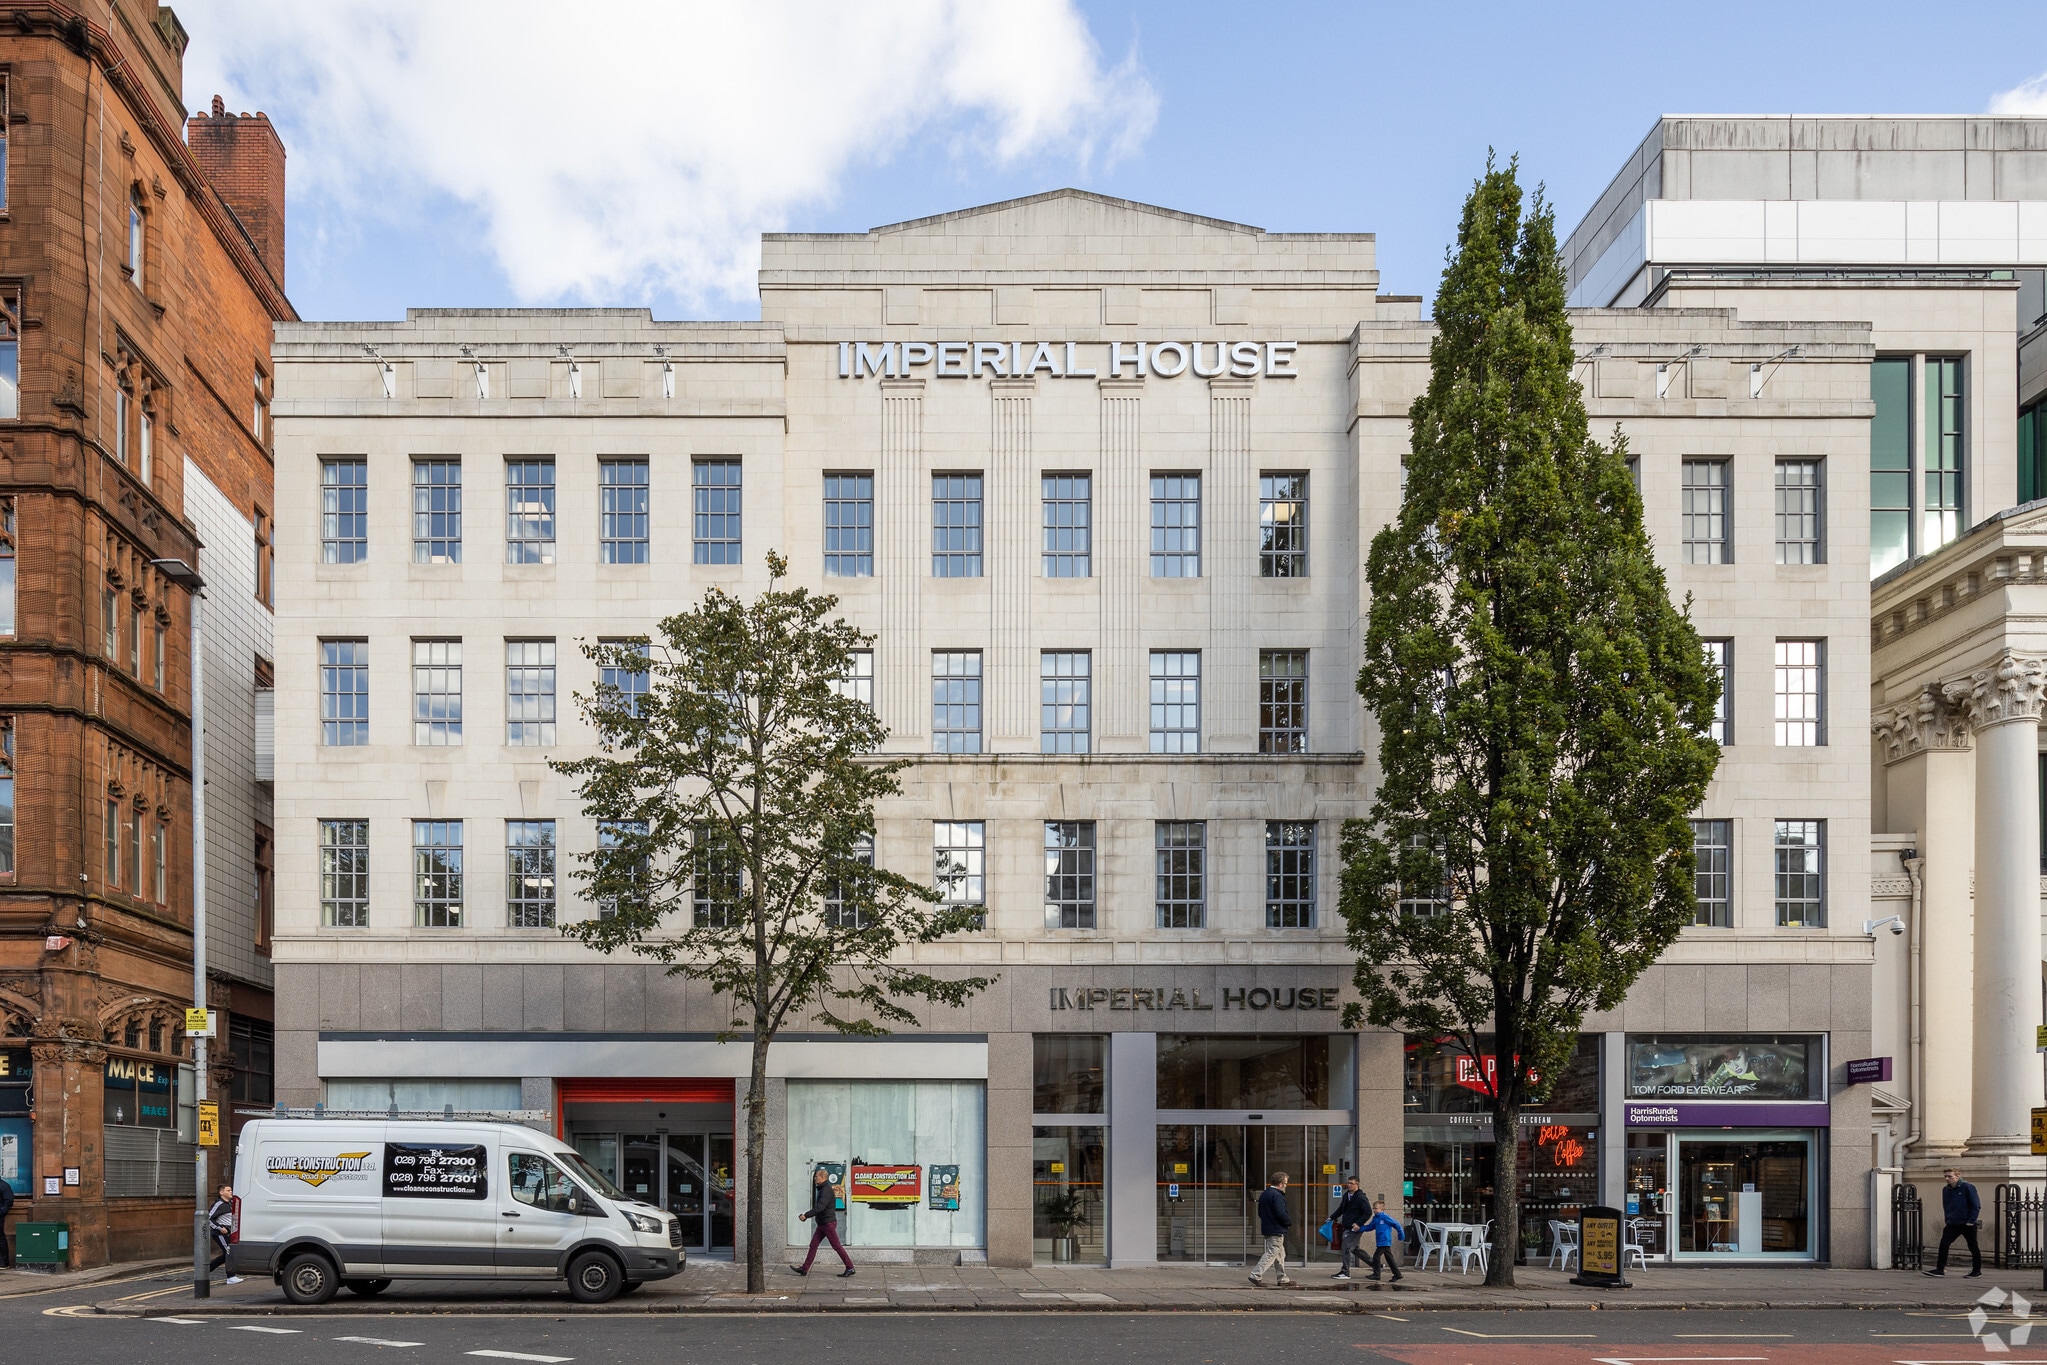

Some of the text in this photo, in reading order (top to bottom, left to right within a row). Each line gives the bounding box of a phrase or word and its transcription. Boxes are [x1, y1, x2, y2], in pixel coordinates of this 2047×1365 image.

[838, 341, 1298, 379] IMPERIAL HOUSE
[1050, 987, 1340, 1011] IMPERIAL HOUSE
[108, 1058, 154, 1083] MACE
[1632, 1085, 1742, 1095] TOM FORD EYEWEAR
[141, 1105, 168, 1117] MACE
[1630, 1107, 1678, 1115] HarrisRundle
[1450, 1116, 1472, 1124] COFFEE
[1530, 1116, 1552, 1124] CREAM
[1630, 1114, 1678, 1123] Optometrists
[1554, 1138, 1584, 1167] Coffee
[266, 1156, 298, 1170] CLOANE
[298, 1157, 362, 1172] CONSTRUCTION
[394, 1155, 476, 1166] (028) 796 27300
[423, 1165, 446, 1175] Fax:
[389, 1172, 477, 1183] (028) 796 27301
[392, 1185, 476, 1194] www.cloaneconstruction.com
